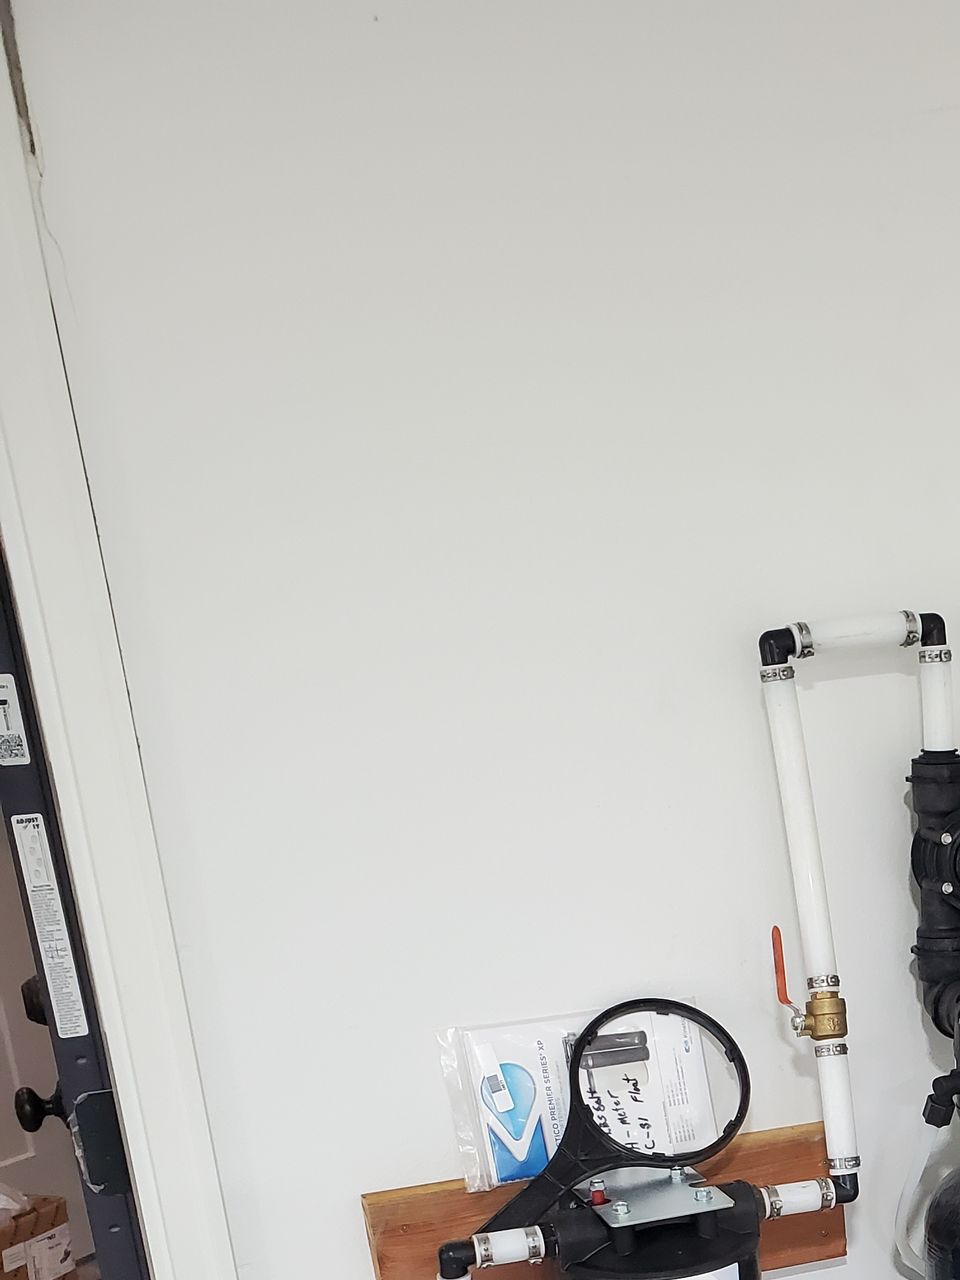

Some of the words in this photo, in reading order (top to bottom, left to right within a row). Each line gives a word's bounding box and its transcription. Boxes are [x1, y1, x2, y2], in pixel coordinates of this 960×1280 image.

[537, 1040, 545, 1051] XP
[546, 1086, 557, 1121] PREMIER
[622, 1073, 644, 1103] Float
[607, 1090, 631, 1125] Meter
